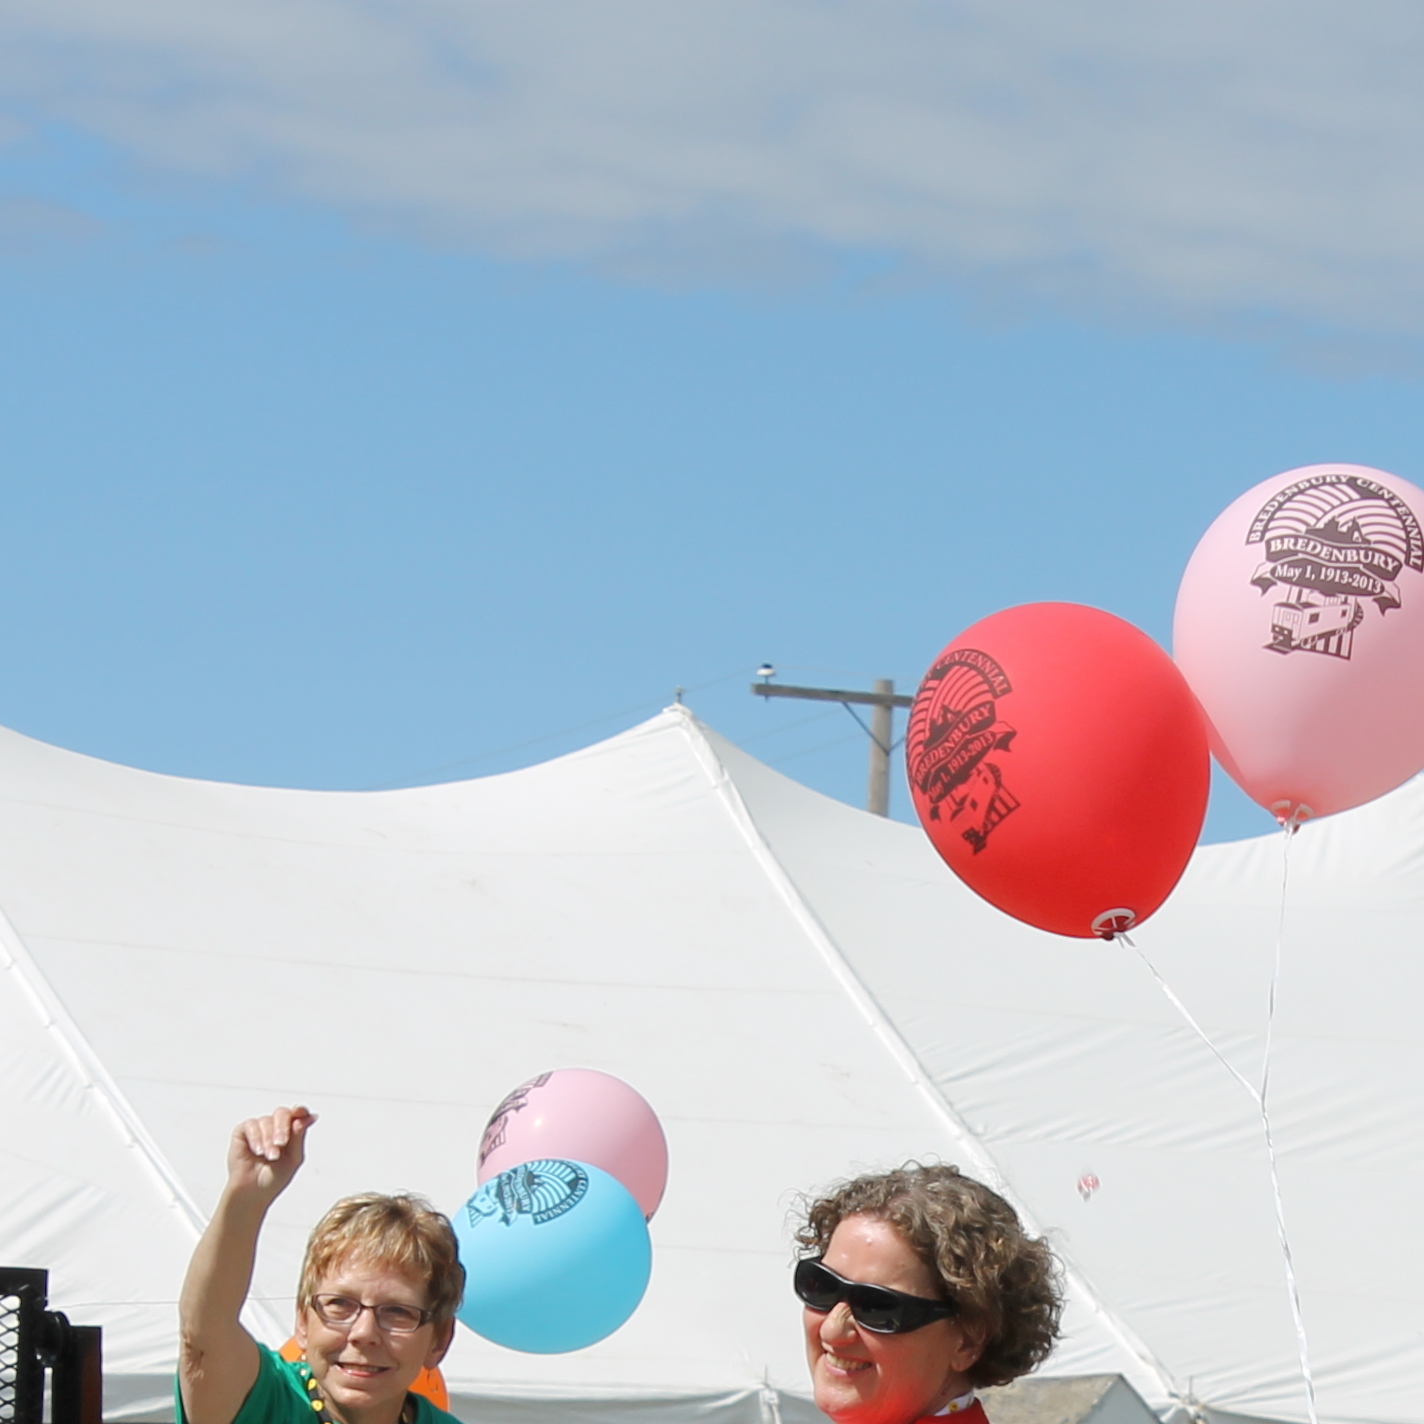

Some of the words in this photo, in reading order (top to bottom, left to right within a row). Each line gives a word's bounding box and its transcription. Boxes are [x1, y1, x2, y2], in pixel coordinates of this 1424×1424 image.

[1248, 475, 1350, 543] BREDENBURY
[1355, 477, 1424, 568] CENTENNIAL
[1269, 538, 1399, 573] BREDENBURY
[1275, 564, 1302, 582] May
